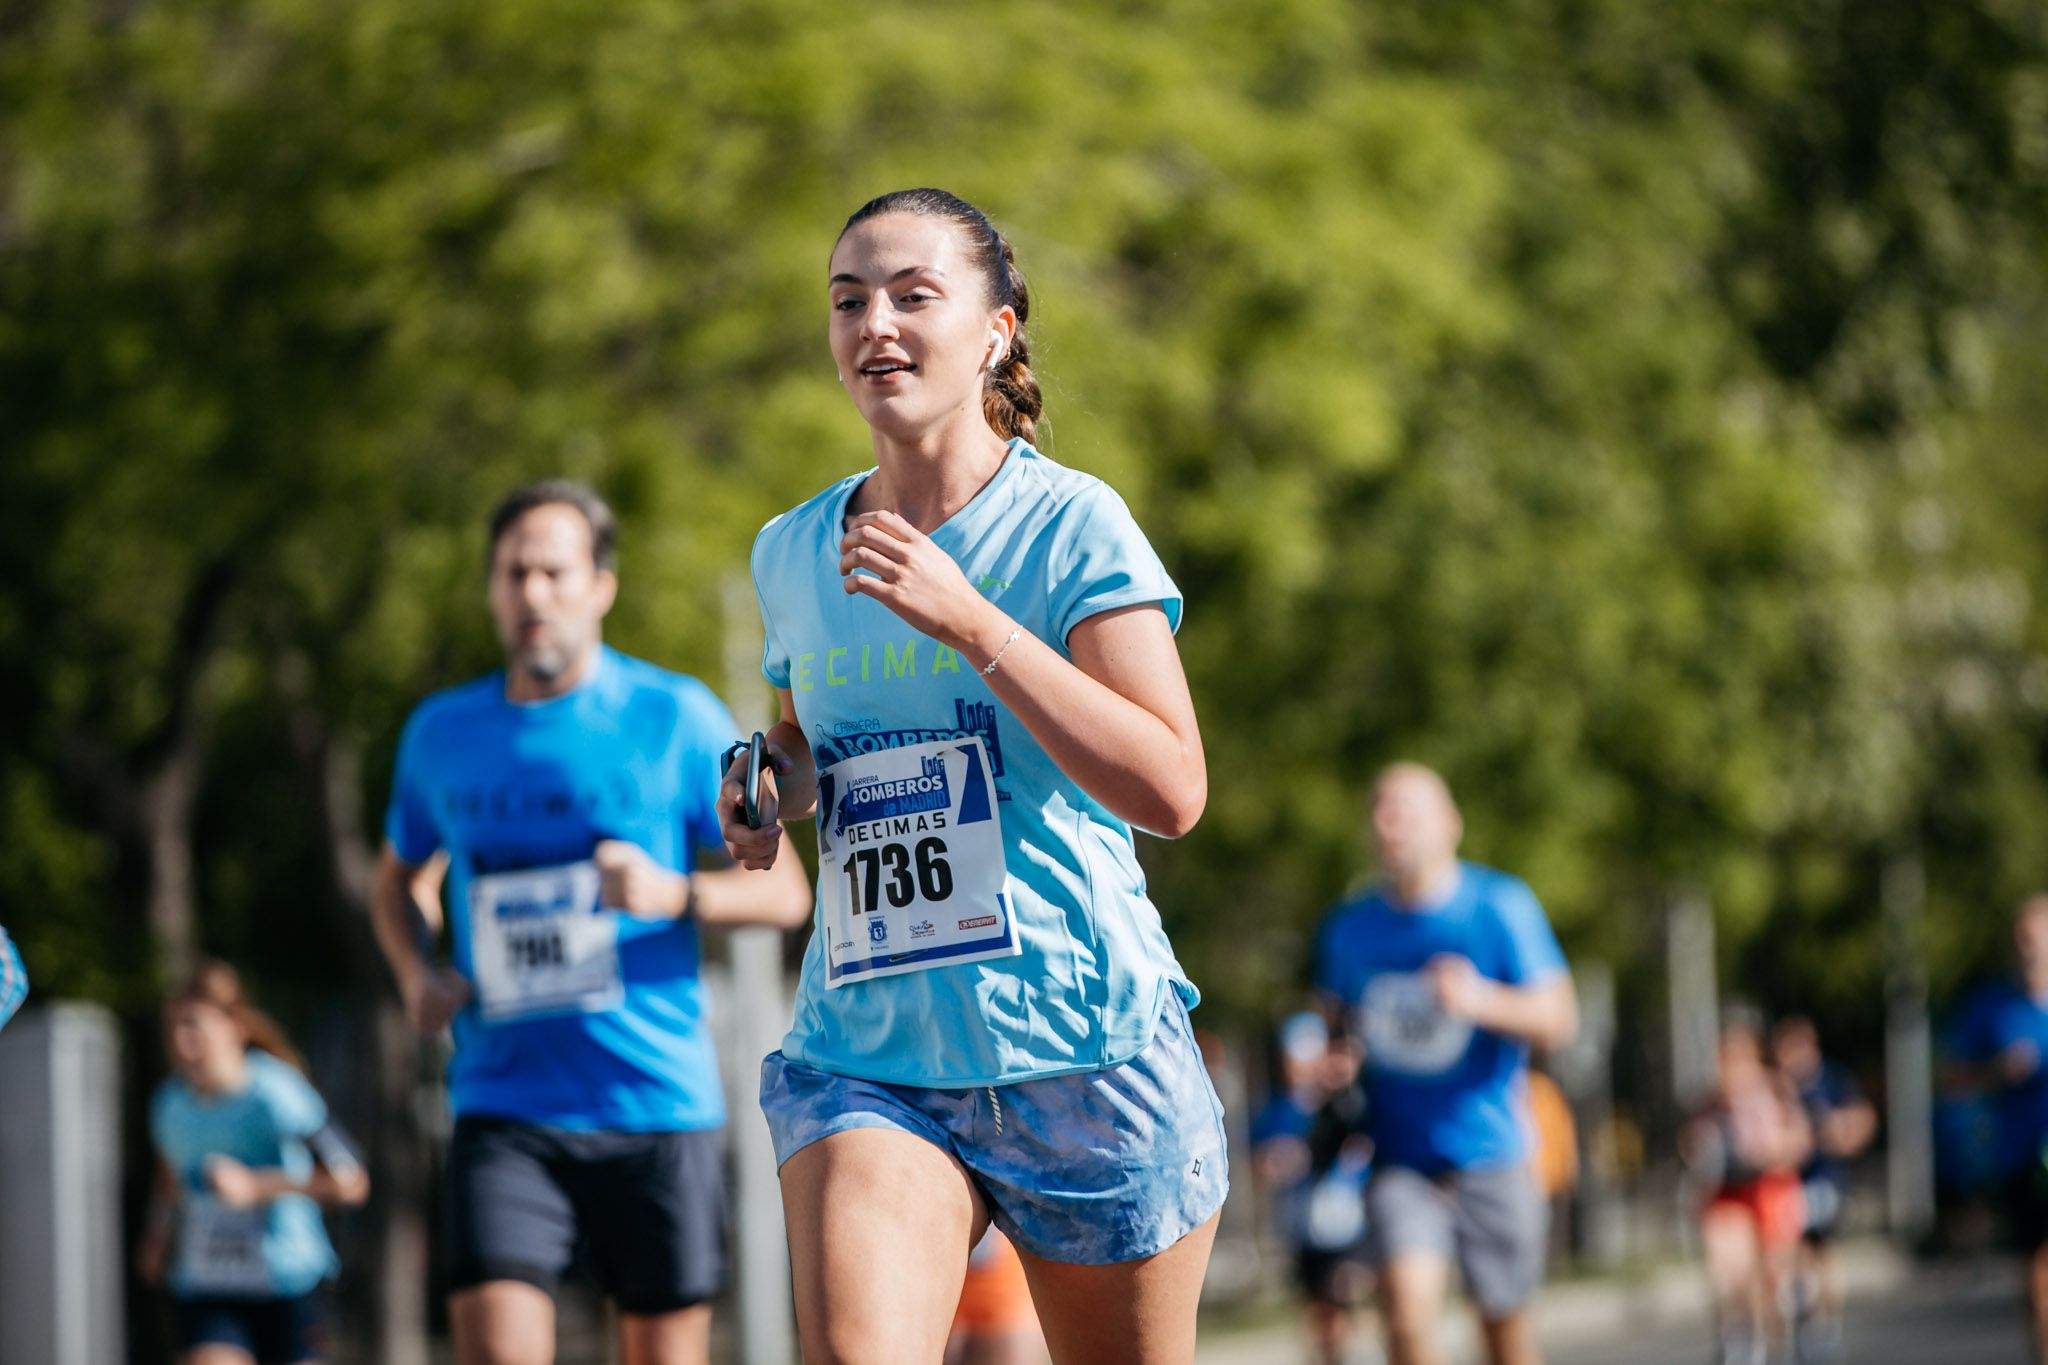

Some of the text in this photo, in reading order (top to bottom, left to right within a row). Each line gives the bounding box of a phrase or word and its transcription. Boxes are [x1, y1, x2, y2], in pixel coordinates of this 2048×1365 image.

[799, 639, 961, 692] ECIMA
[852, 775, 944, 805] BOMBEROS
[883, 792, 945, 816] de MADRID
[848, 811, 947, 845] DECIMAS
[843, 836, 954, 916] 1736
